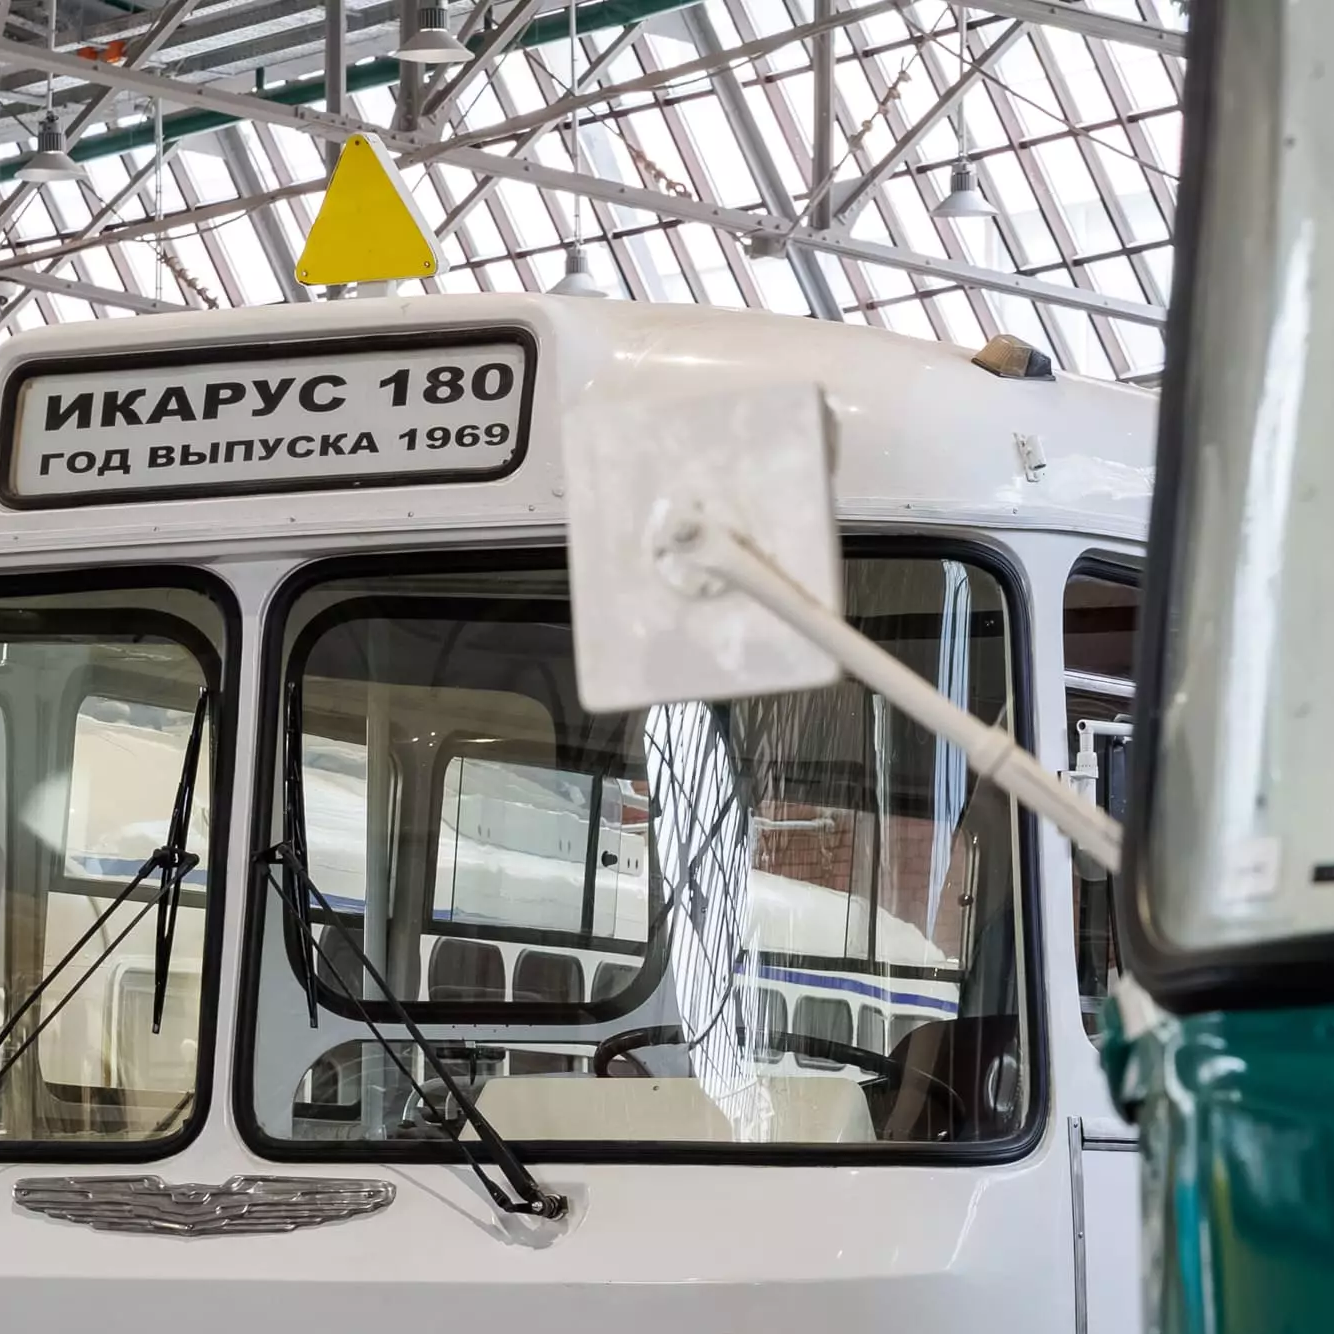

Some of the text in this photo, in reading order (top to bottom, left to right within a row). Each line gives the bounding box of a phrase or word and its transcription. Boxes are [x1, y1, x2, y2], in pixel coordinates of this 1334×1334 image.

[44, 362, 516, 431] ИКАРУС 180
[39, 423, 511, 477] ГОД ВЫПУСКА 1969
